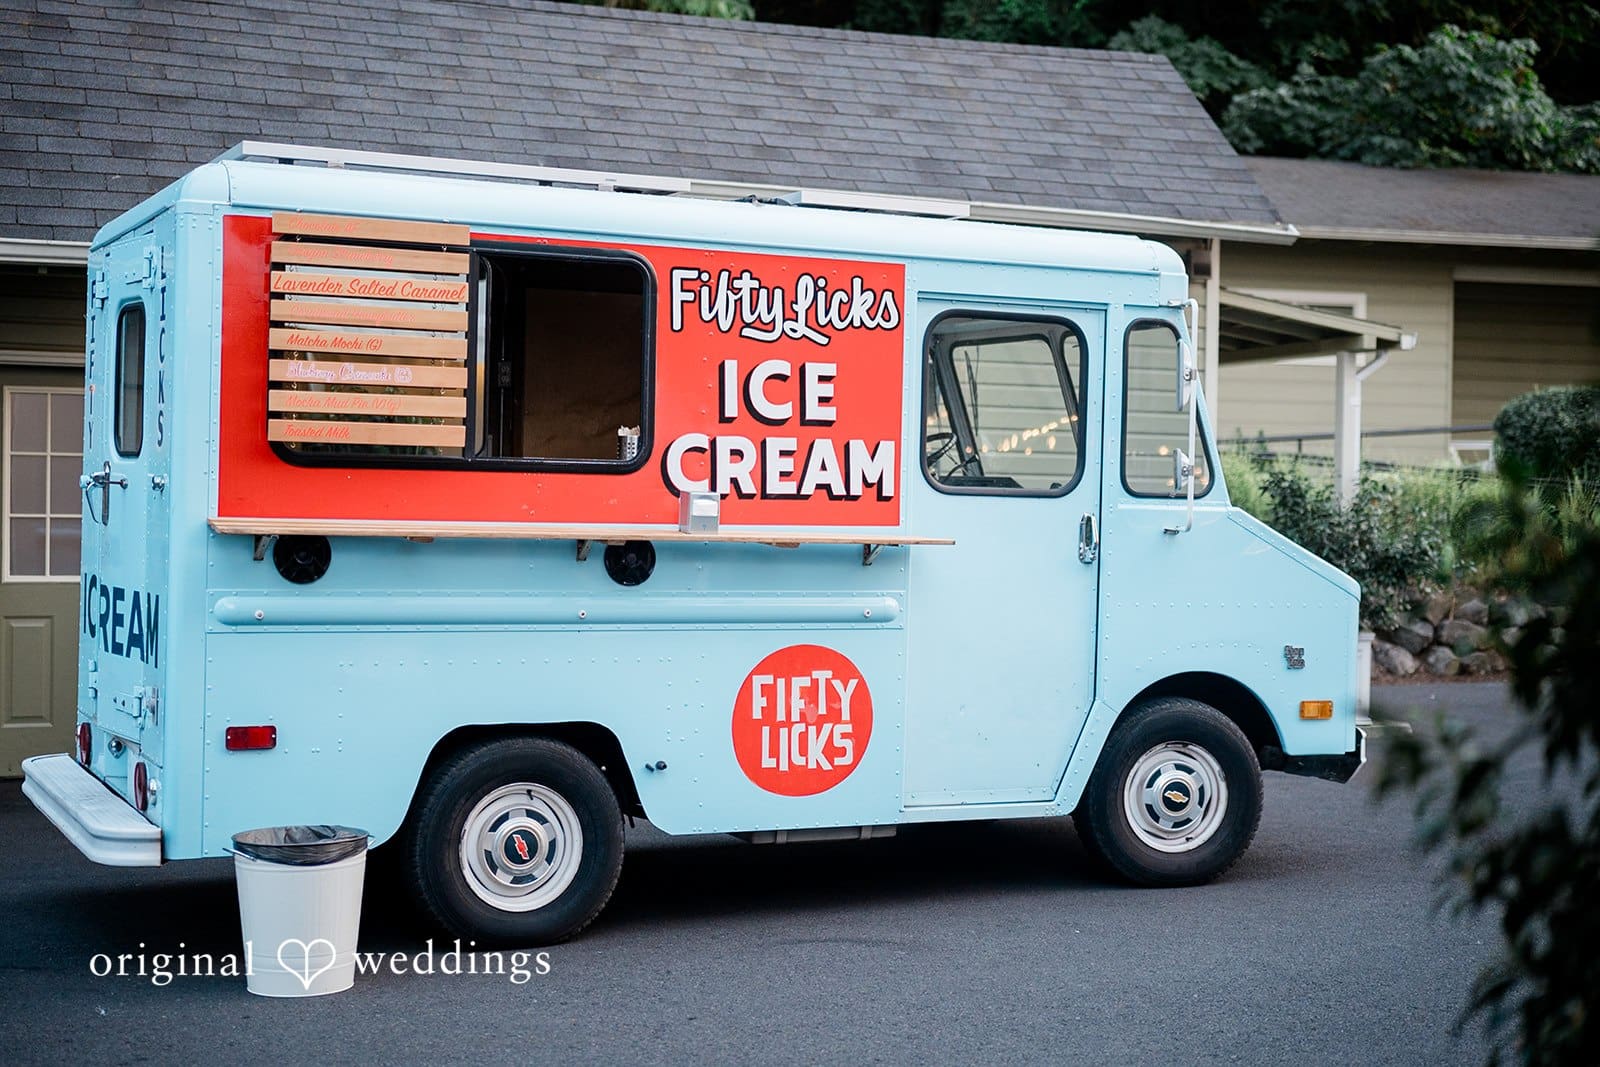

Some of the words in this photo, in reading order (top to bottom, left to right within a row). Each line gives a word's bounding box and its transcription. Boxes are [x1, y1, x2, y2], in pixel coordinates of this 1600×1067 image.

[273, 275, 343, 294] Lavender
[347, 278, 398, 297] Salted
[400, 281, 466, 300] Caramel
[670, 266, 785, 343] Fifty
[782, 272, 902, 346] Licks
[286, 333, 328, 348] Matcha
[330, 336, 363, 350] Mochi
[365, 338, 383, 352] (G)
[718, 359, 838, 427] ICE
[284, 423, 323, 437] Toasted
[325, 425, 351, 439] Milk
[661, 433, 896, 502] CREAM
[752, 670, 860, 722] FIFTY
[761, 722, 854, 772] LICKS
